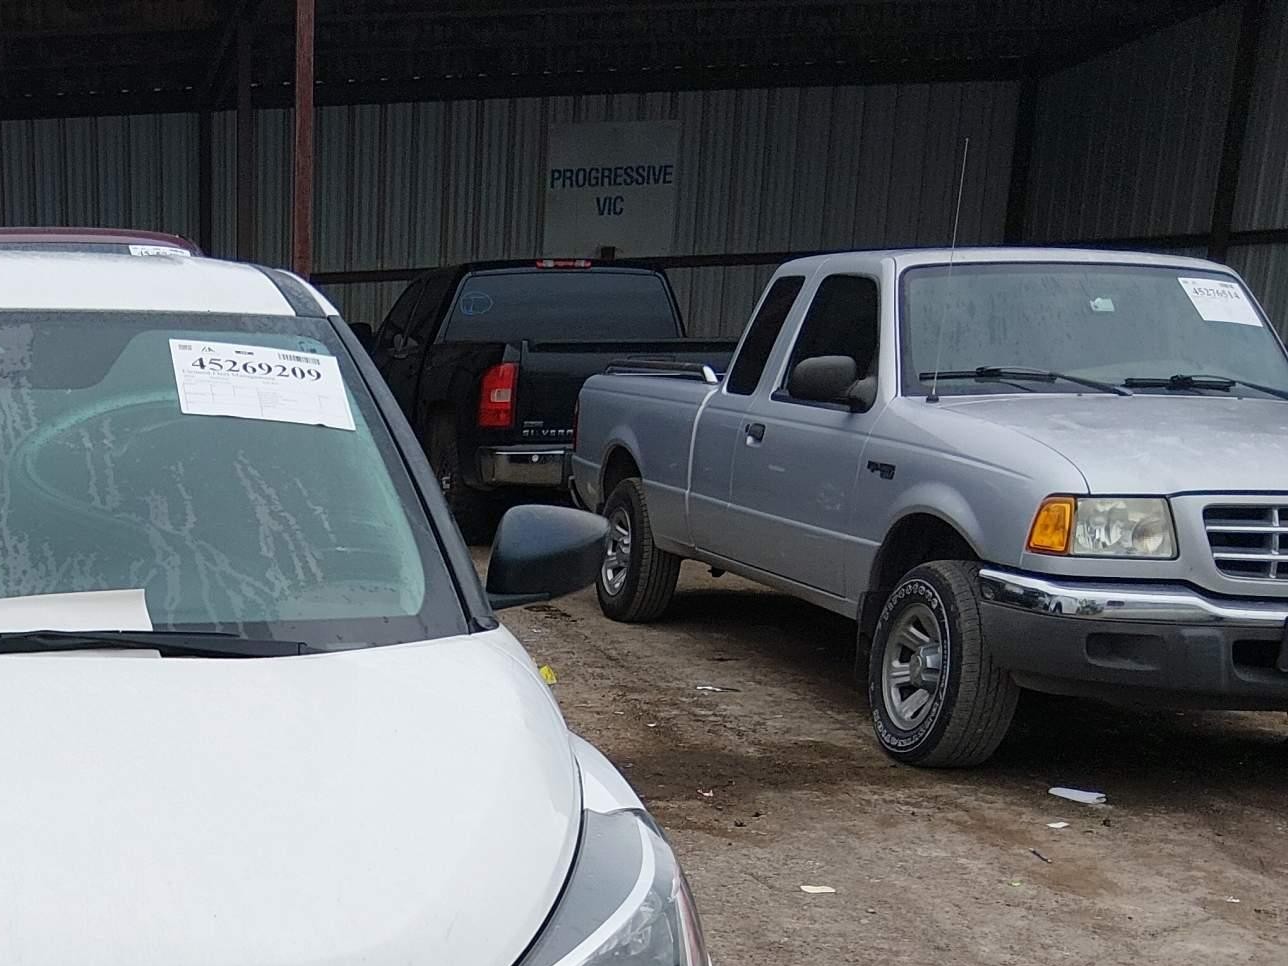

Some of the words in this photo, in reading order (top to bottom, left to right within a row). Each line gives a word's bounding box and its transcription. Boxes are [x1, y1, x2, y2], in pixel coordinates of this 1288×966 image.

[550, 165, 674, 189] PROGRESSIVE
[595, 195, 624, 216] VIC
[191, 356, 322, 382] 45269209
